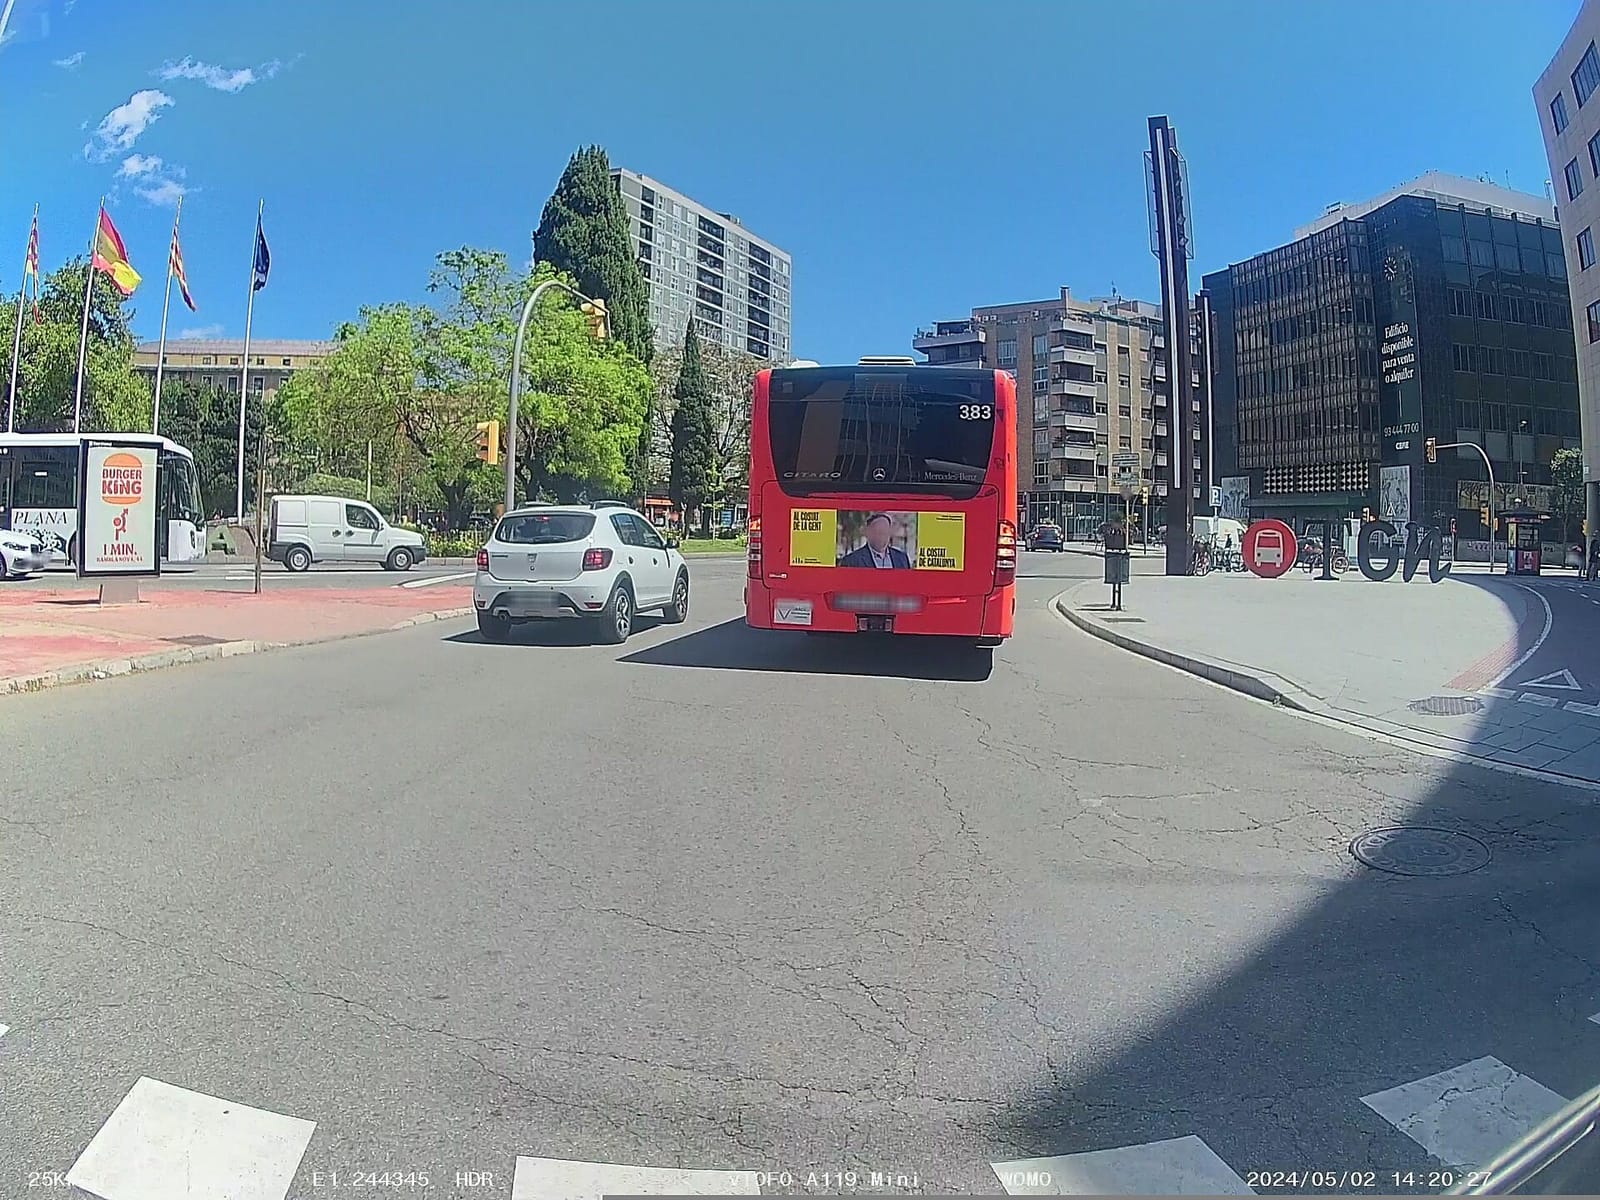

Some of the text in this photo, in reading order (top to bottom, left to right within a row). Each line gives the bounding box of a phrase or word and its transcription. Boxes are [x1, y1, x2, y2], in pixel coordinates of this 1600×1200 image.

[1384, 322, 1409, 339] Edificio
[1381, 336, 1414, 355] disponible
[1382, 352, 1415, 373] para venta
[1390, 367, 1414, 385] alquiler
[959, 404, 991, 420] 383
[102, 468, 142, 480] BURGER
[924, 471, 977, 481] Mercedes-Benz
[101, 480, 142, 495] KING
[14, 511, 68, 525] PLANA
[808, 521, 821, 531] GENT
[109, 543, 137, 556] MIN.
